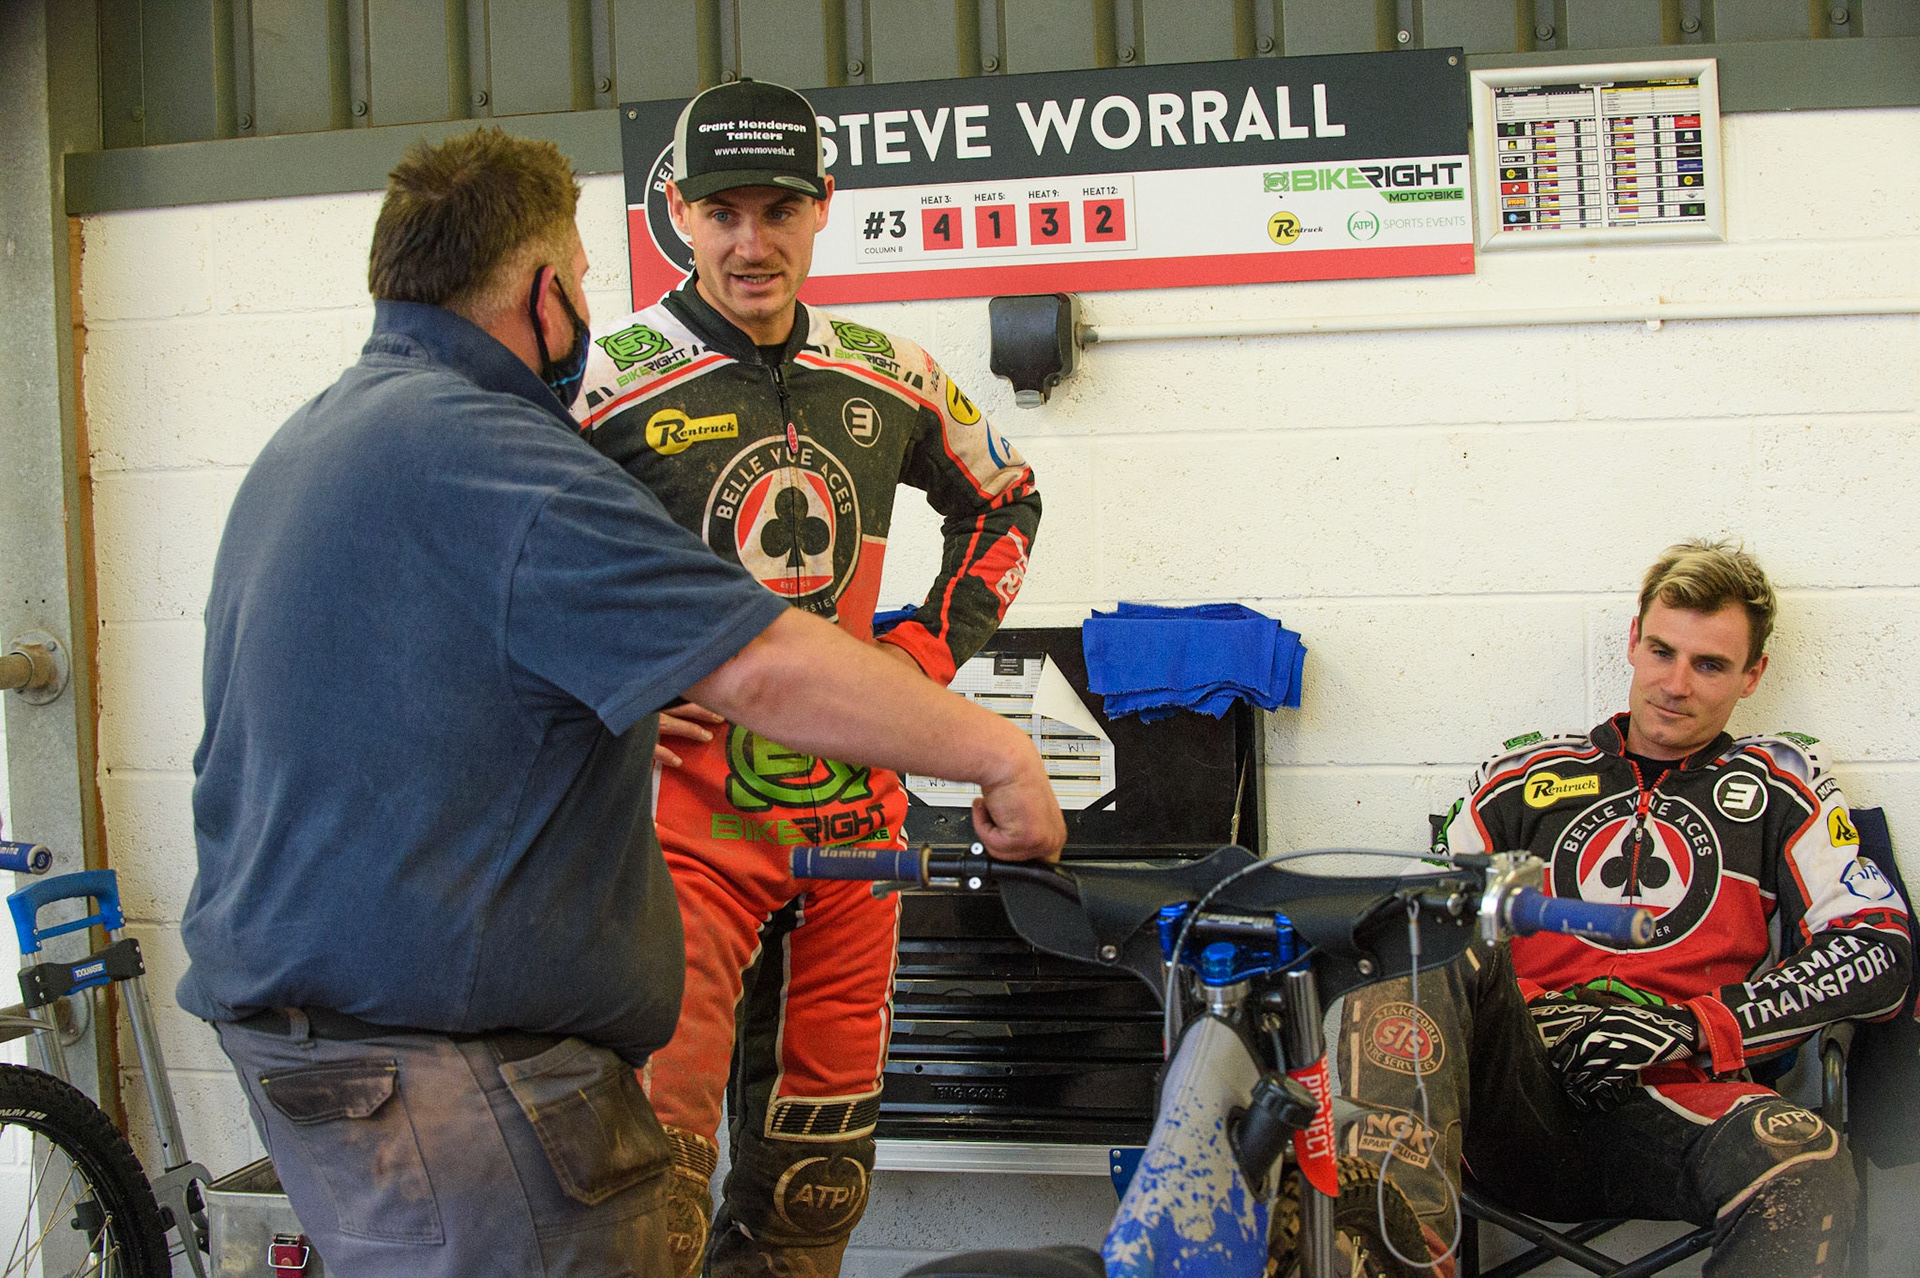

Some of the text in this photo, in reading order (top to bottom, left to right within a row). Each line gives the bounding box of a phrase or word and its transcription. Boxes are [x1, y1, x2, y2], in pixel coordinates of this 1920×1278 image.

[698, 119, 807, 133] Grant Henderson
[1015, 82, 1347, 157] WORRALL
[726, 131, 784, 141] Tankers
[1291, 162, 1463, 192] BIKERIGHT
[920, 196, 952, 205] HEAT 3:
[974, 193, 1006, 202] HEAT 5:
[1028, 189, 1060, 199] HEAT 9:
[1082, 186, 1119, 196] HEAT 12:
[1389, 190, 1464, 203] MOTORBIKE
[933, 213, 950, 242] 4
[988, 210, 1001, 239] 1
[1040, 208, 1059, 237] 3
[1095, 205, 1113, 234] 2
[1273, 219, 1324, 239] Rentruck
[1352, 216, 1466, 231] ATPI SPORTS EVENTS
[864, 247, 897, 255] COLUMN
[653, 418, 735, 448] Rentruck
[715, 455, 765, 520] BELLE
[820, 462, 852, 515] ACES
[1530, 779, 1597, 800] Rentruck
[1563, 805, 1618, 853] BELLE
[1675, 813, 1713, 857] ACES
[819, 846, 877, 860] domino
[1379, 1020, 1425, 1055] STS
[1384, 1055, 1438, 1073] SERVCES
[1766, 1110, 1815, 1134] ATPI
[1366, 1113, 1434, 1154] NGK
[789, 1183, 857, 1210] ATPI
